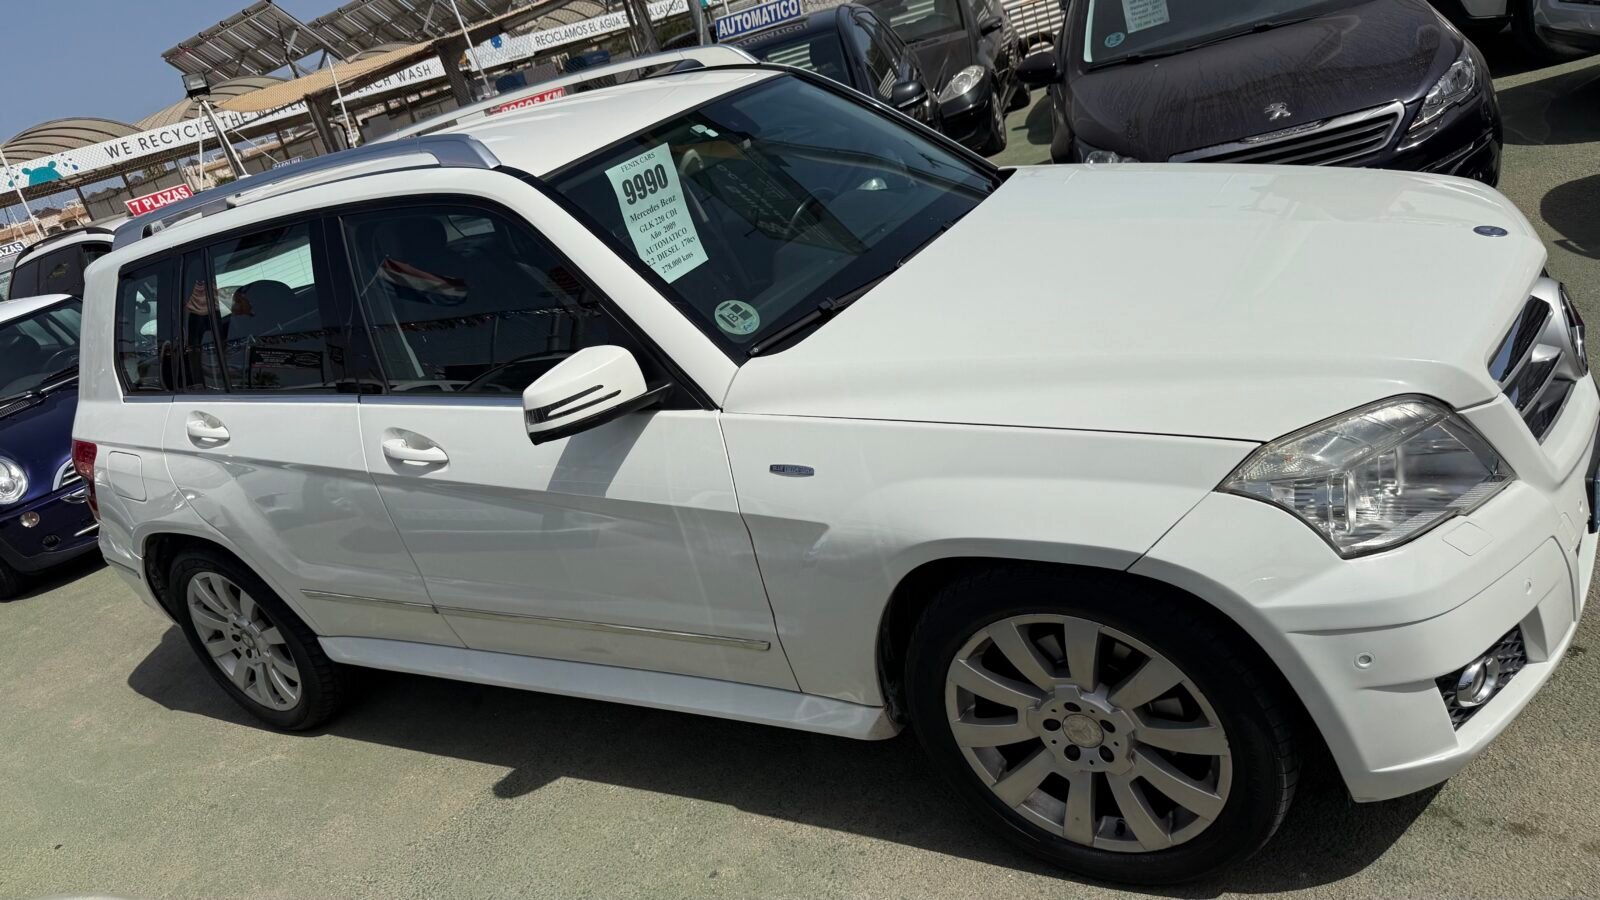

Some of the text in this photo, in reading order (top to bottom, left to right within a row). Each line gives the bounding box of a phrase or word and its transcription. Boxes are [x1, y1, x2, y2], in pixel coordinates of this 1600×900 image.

[535, 24, 588, 47] RECICLAMOS
[589, 22, 599, 34] EL
[600, 17, 621, 32] AGUA
[655, 0, 684, 16] LAVADO
[719, 0, 798, 37] AUTOMATICO
[545, 88, 563, 102] KM
[104, 141, 132, 159] WE
[138, 120, 215, 151] RECYCLE
[221, 113, 247, 129] THE
[395, 65, 432, 82] WASH
[620, 152, 655, 173] FENIX CARS
[622, 164, 668, 205] 9990
[131, 187, 190, 212] 7 PLAZAS
[629, 195, 677, 222] Mercedes Benz
[639, 208, 678, 233] GLK 220 CDI
[650, 221, 677, 241] Año 2009
[645, 227, 688, 256] AUTOMATICO
[657, 244, 680, 262] DIESEL
[661, 251, 694, 274] 278.000 kms
[727, 313, 739, 323] B
